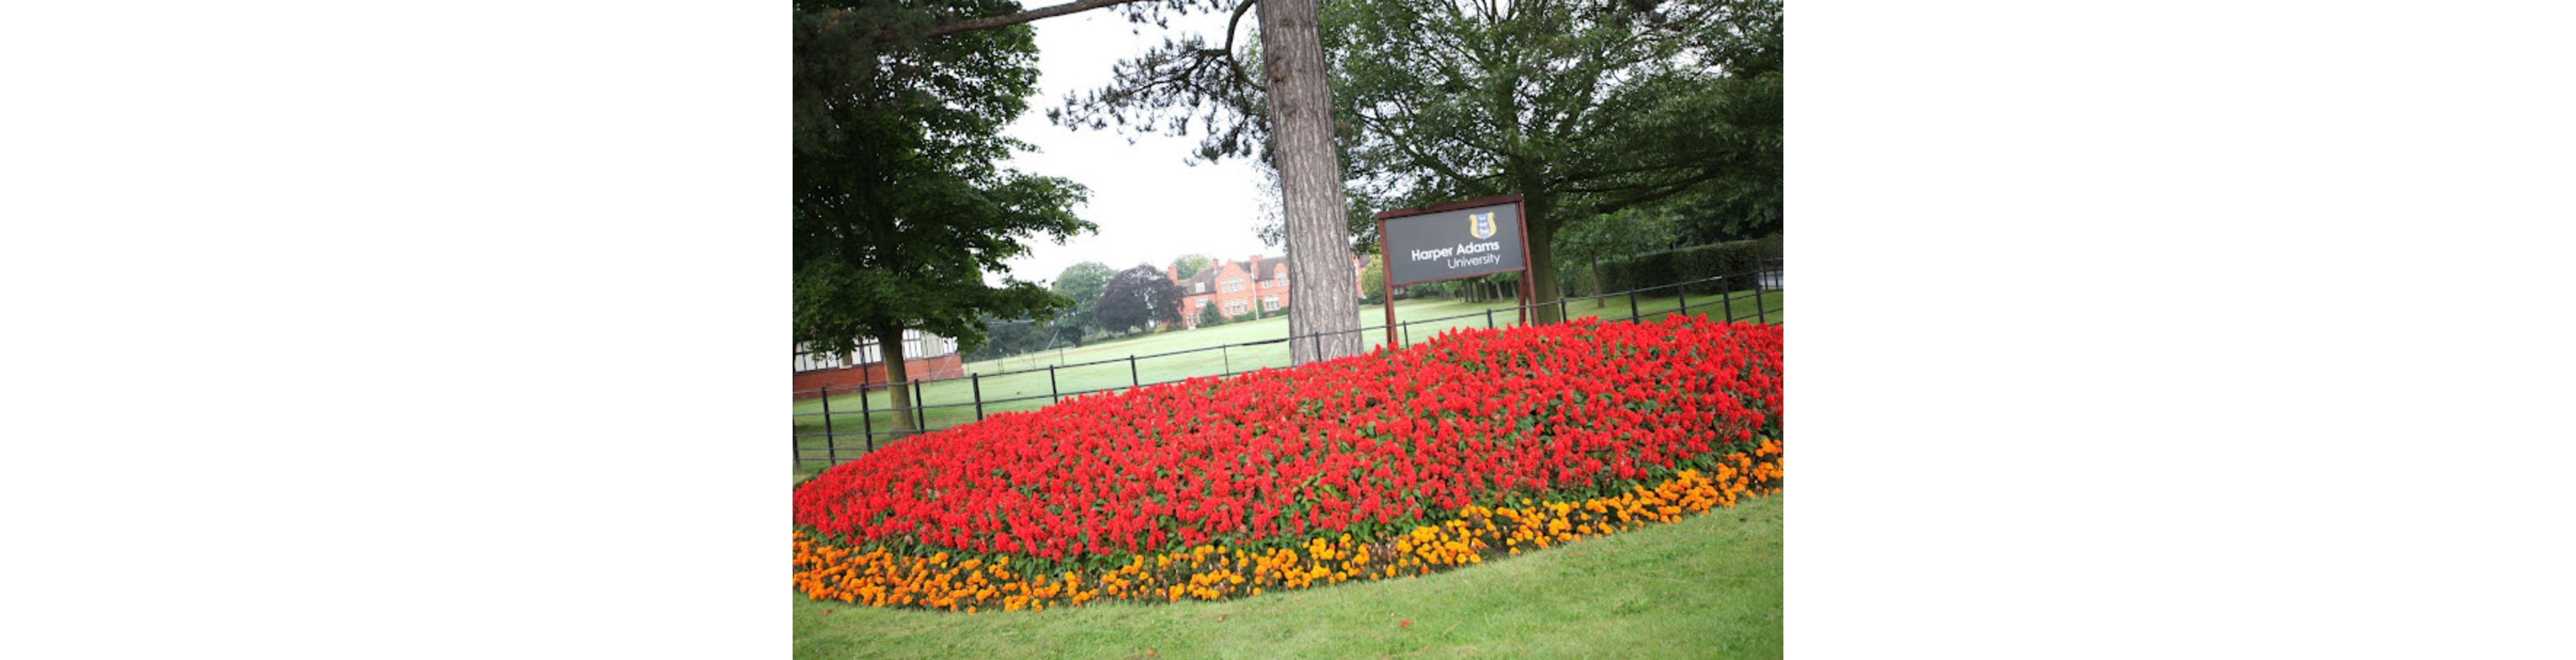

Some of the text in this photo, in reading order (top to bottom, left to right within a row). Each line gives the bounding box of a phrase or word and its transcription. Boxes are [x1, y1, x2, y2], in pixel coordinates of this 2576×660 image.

[1411, 241, 1500, 261] Harper Adams
[1447, 253, 1500, 269] University
